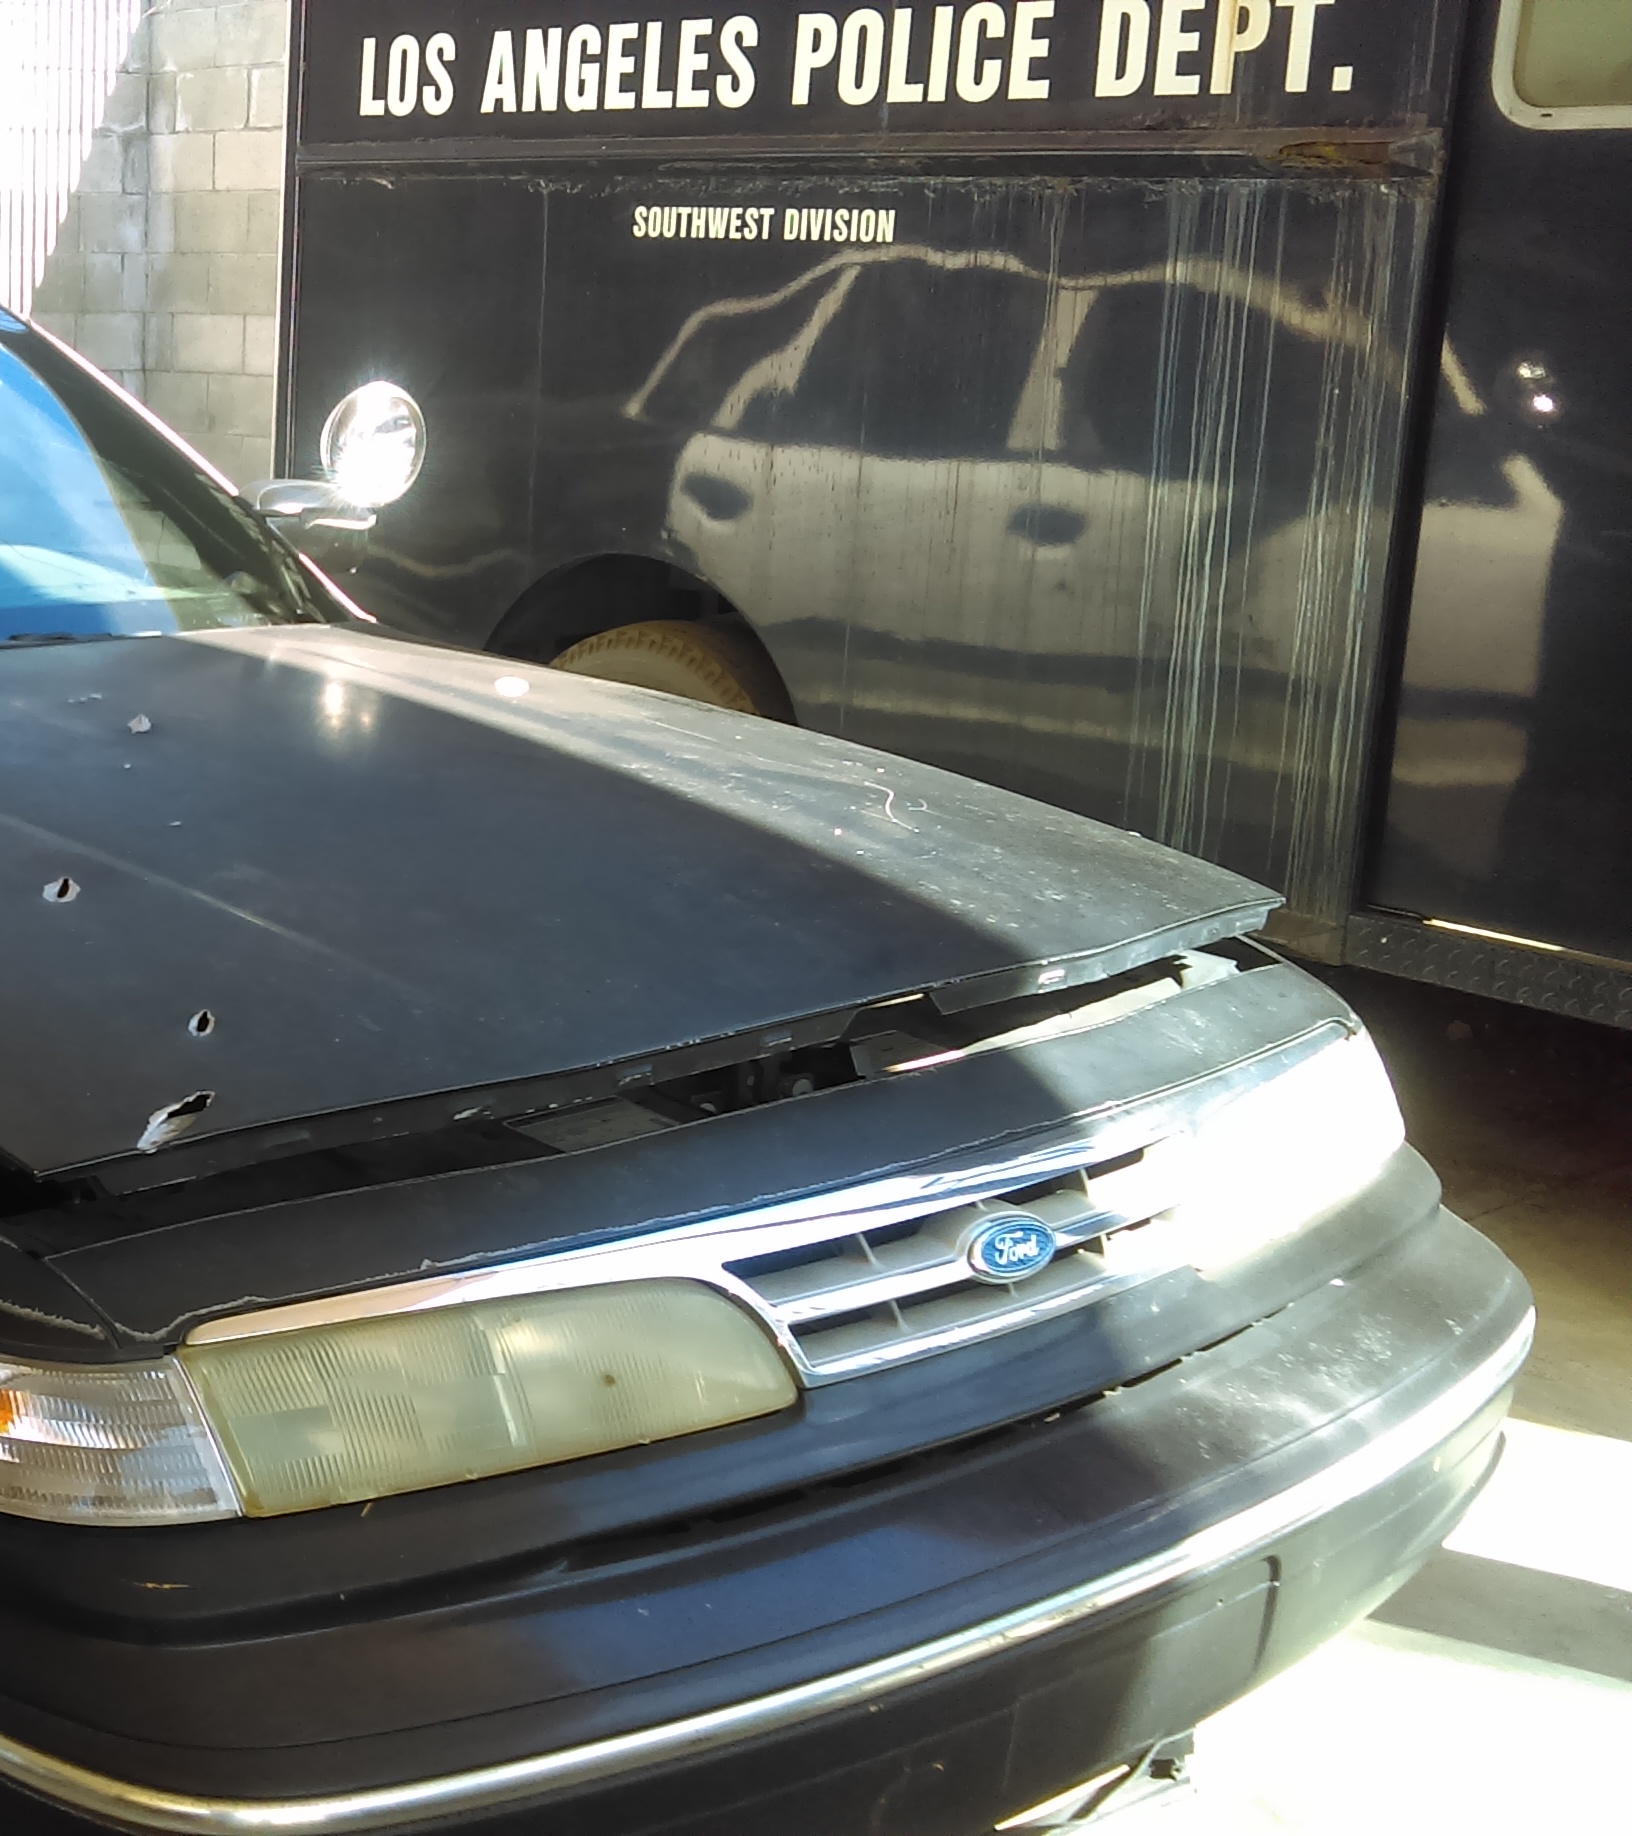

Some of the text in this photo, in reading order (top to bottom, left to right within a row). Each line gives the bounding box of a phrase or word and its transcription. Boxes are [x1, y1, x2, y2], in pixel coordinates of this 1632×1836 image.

[360, 0, 1353, 116] LOS ANGELES POLICE DEPT.
[632, 205, 896, 244] SOUTHWEST DIVISION
[995, 1231, 1040, 1265] Ford
